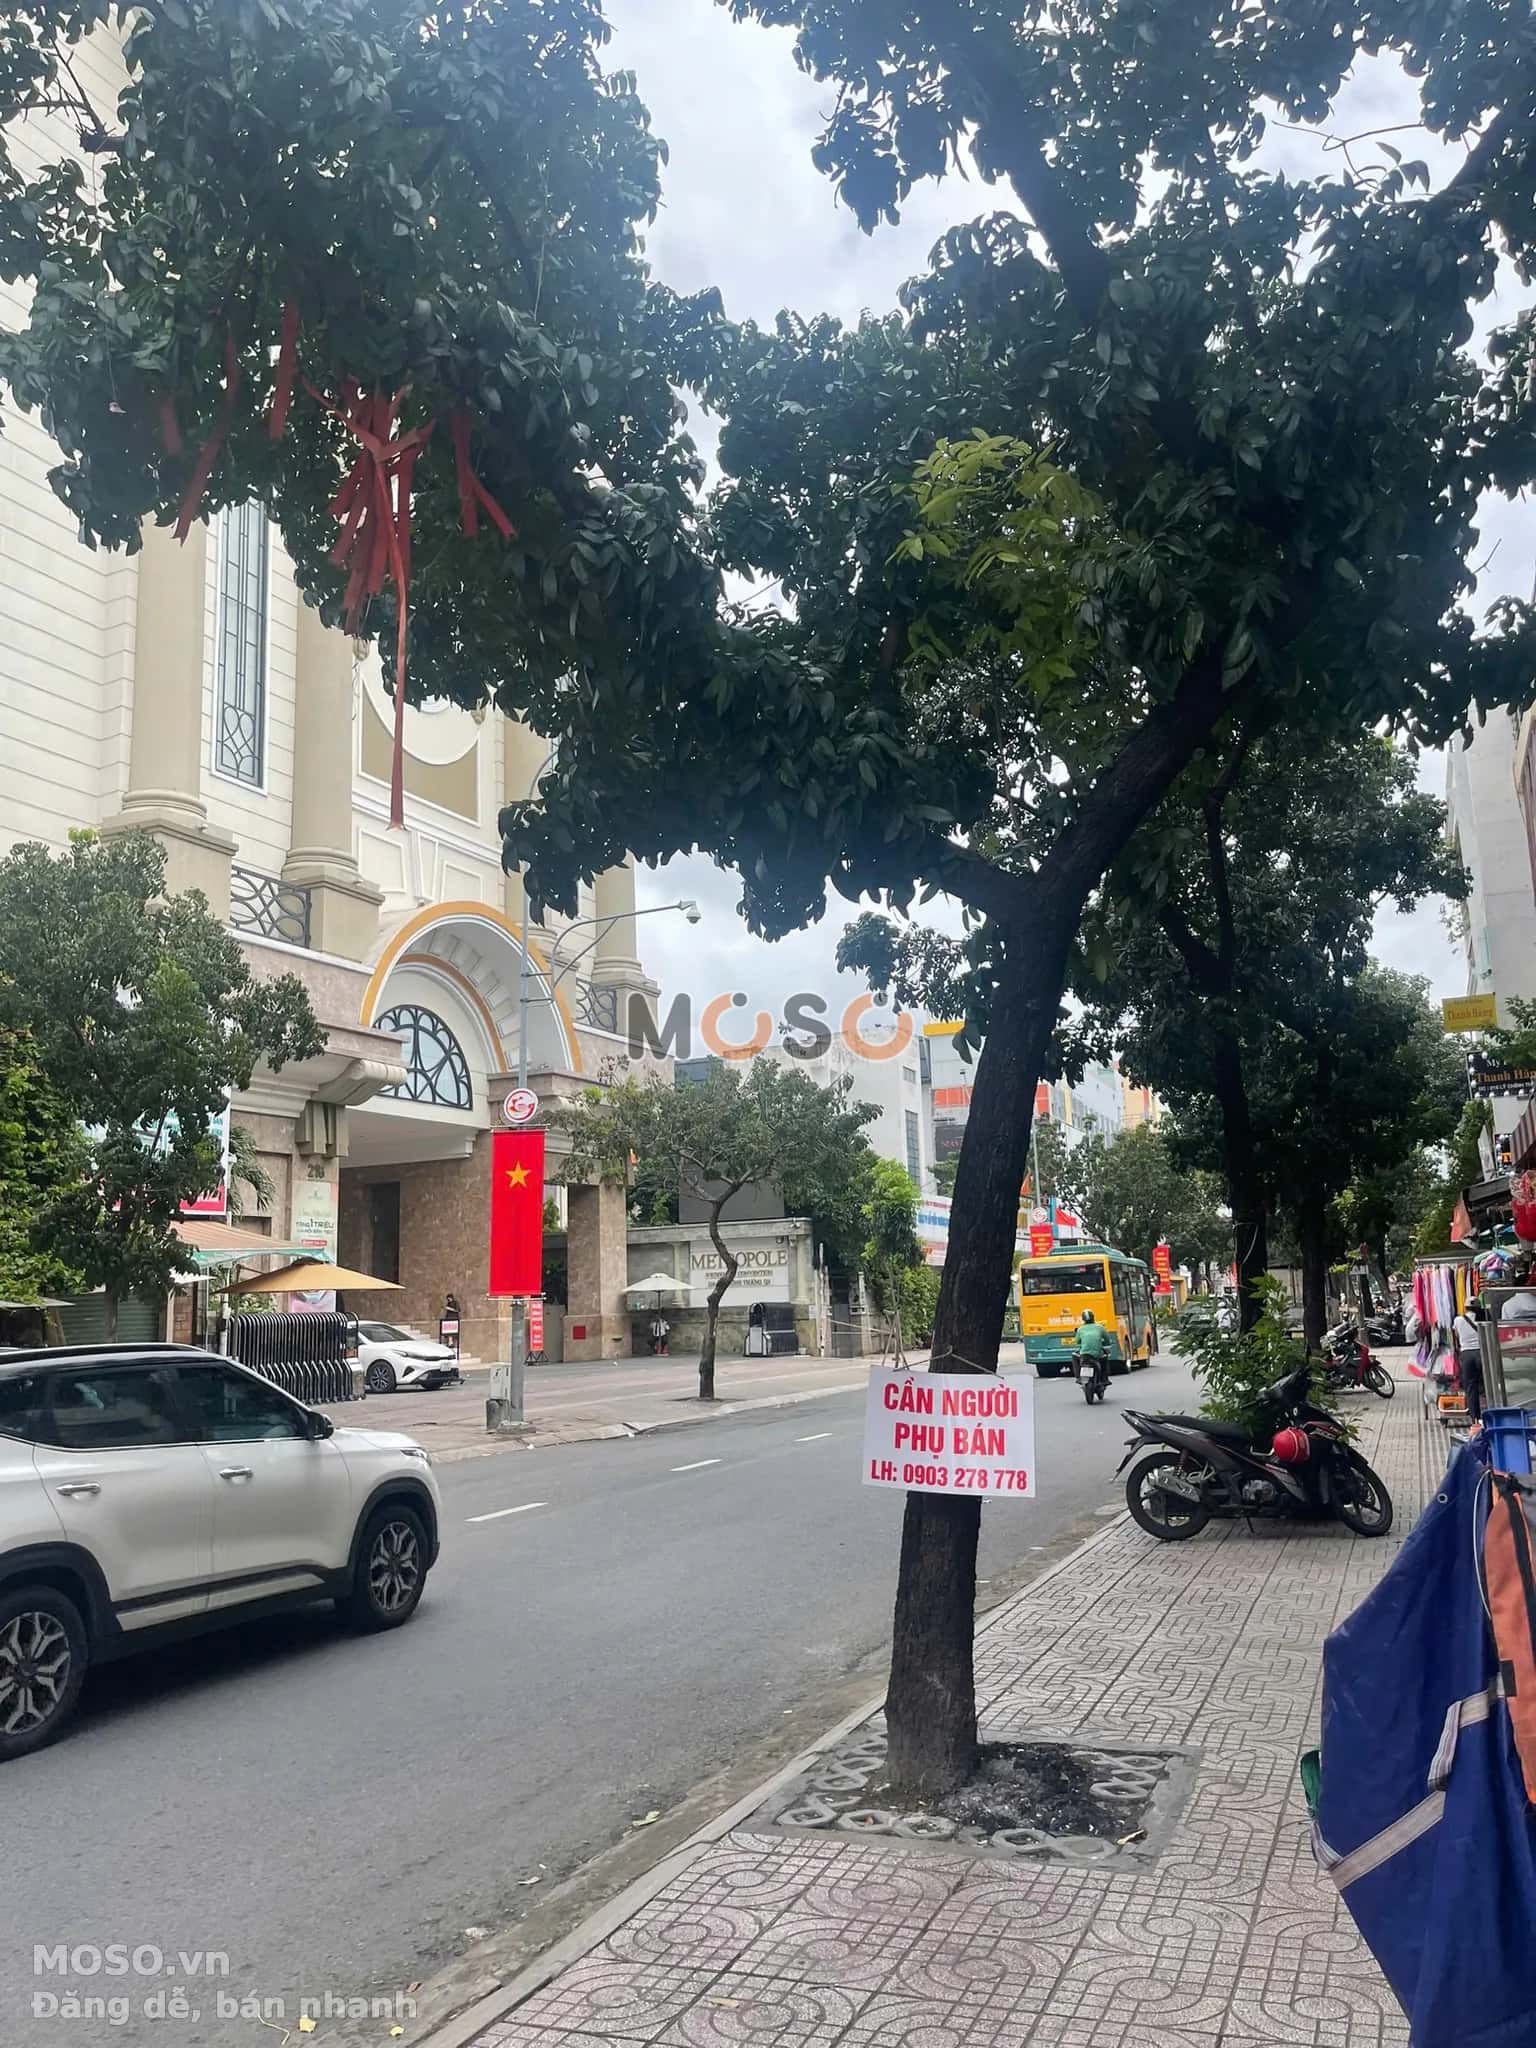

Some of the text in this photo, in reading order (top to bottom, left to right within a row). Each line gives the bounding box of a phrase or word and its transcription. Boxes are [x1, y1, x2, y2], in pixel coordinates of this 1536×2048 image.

[691, 1250, 788, 1270] METOPOLE
[884, 1377, 1018, 1417] CẦN NGƯỜI
[895, 1422, 1005, 1459] PHỤ BÁN
[871, 1459, 1028, 1490] LH: 0903 278 778
